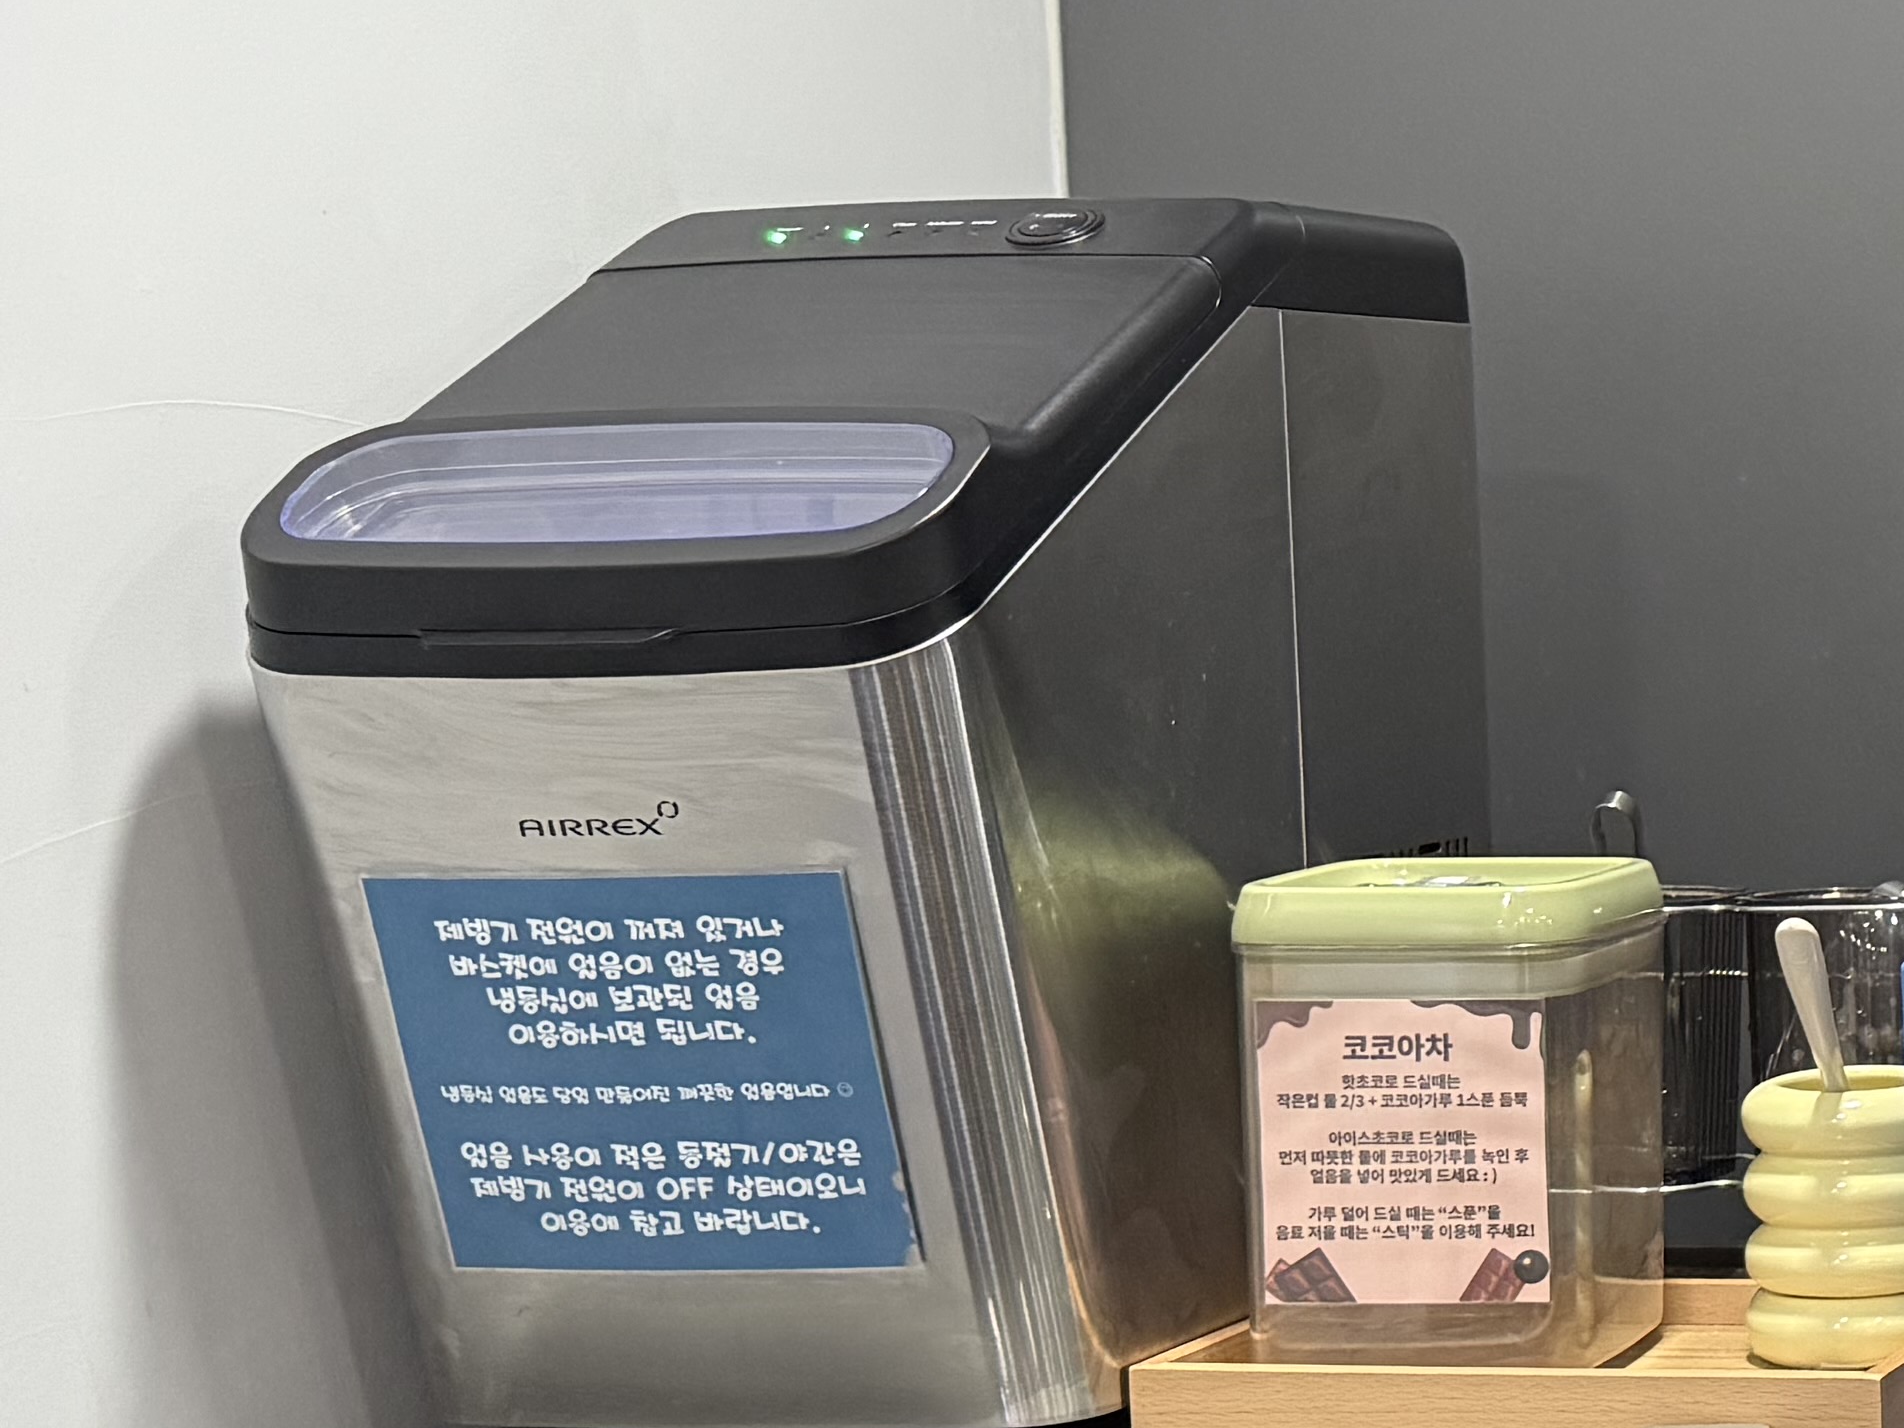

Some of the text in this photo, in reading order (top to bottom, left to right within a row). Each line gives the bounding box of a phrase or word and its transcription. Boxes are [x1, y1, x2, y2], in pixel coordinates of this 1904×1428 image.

[519, 817, 664, 838] AIRREX
[434, 914, 784, 945] 제빙기 전원이 꺼져 있거나
[449, 947, 785, 980] 바스켓에 얼음이 없는 경우
[486, 981, 760, 1014] 냉동실에 보관된 얼음
[508, 1018, 757, 1048] 이용하시면 됩니다.
[1342, 1033, 1453, 1062] 코코아차
[1342, 1073, 1461, 1090] 핫초코로 드실때는
[441, 1084, 493, 1104] 냉동실
[1276, 1093, 1319, 1109] 작은컵
[1340, 1094, 1365, 1110] 2/3
[1380, 1093, 1452, 1109] 코코아가루
[1328, 1130, 1477, 1146] 아이스초코로 드실때는
[460, 1138, 862, 1169] 얼음 사용이 적은 동절기/야간은
[1278, 1149, 1307, 1166] 먼저
[1311, 1149, 1353, 1166] 따뜻한
[1391, 1149, 1476, 1165] 코코아가루를
[1482, 1148, 1510, 1164] 녹인
[1514, 1147, 1530, 1164] 후
[1310, 1168, 1352, 1184] 얼음을
[1389, 1168, 1432, 1184] 맛있게
[470, 1172, 867, 1203] 제빙기 전원이 OFF 상태이오니
[541, 1207, 821, 1237] 이용에 참고 바랍니다.
[1308, 1205, 1337, 1221] 가루
[1373, 1205, 1401, 1221] 드실
[1405, 1205, 1435, 1221] 때는
[1276, 1224, 1305, 1241] 음료
[1340, 1224, 1368, 1240] 때는
[1439, 1223, 1482, 1240] 이용해
[1486, 1223, 1535, 1239] 주세요!
